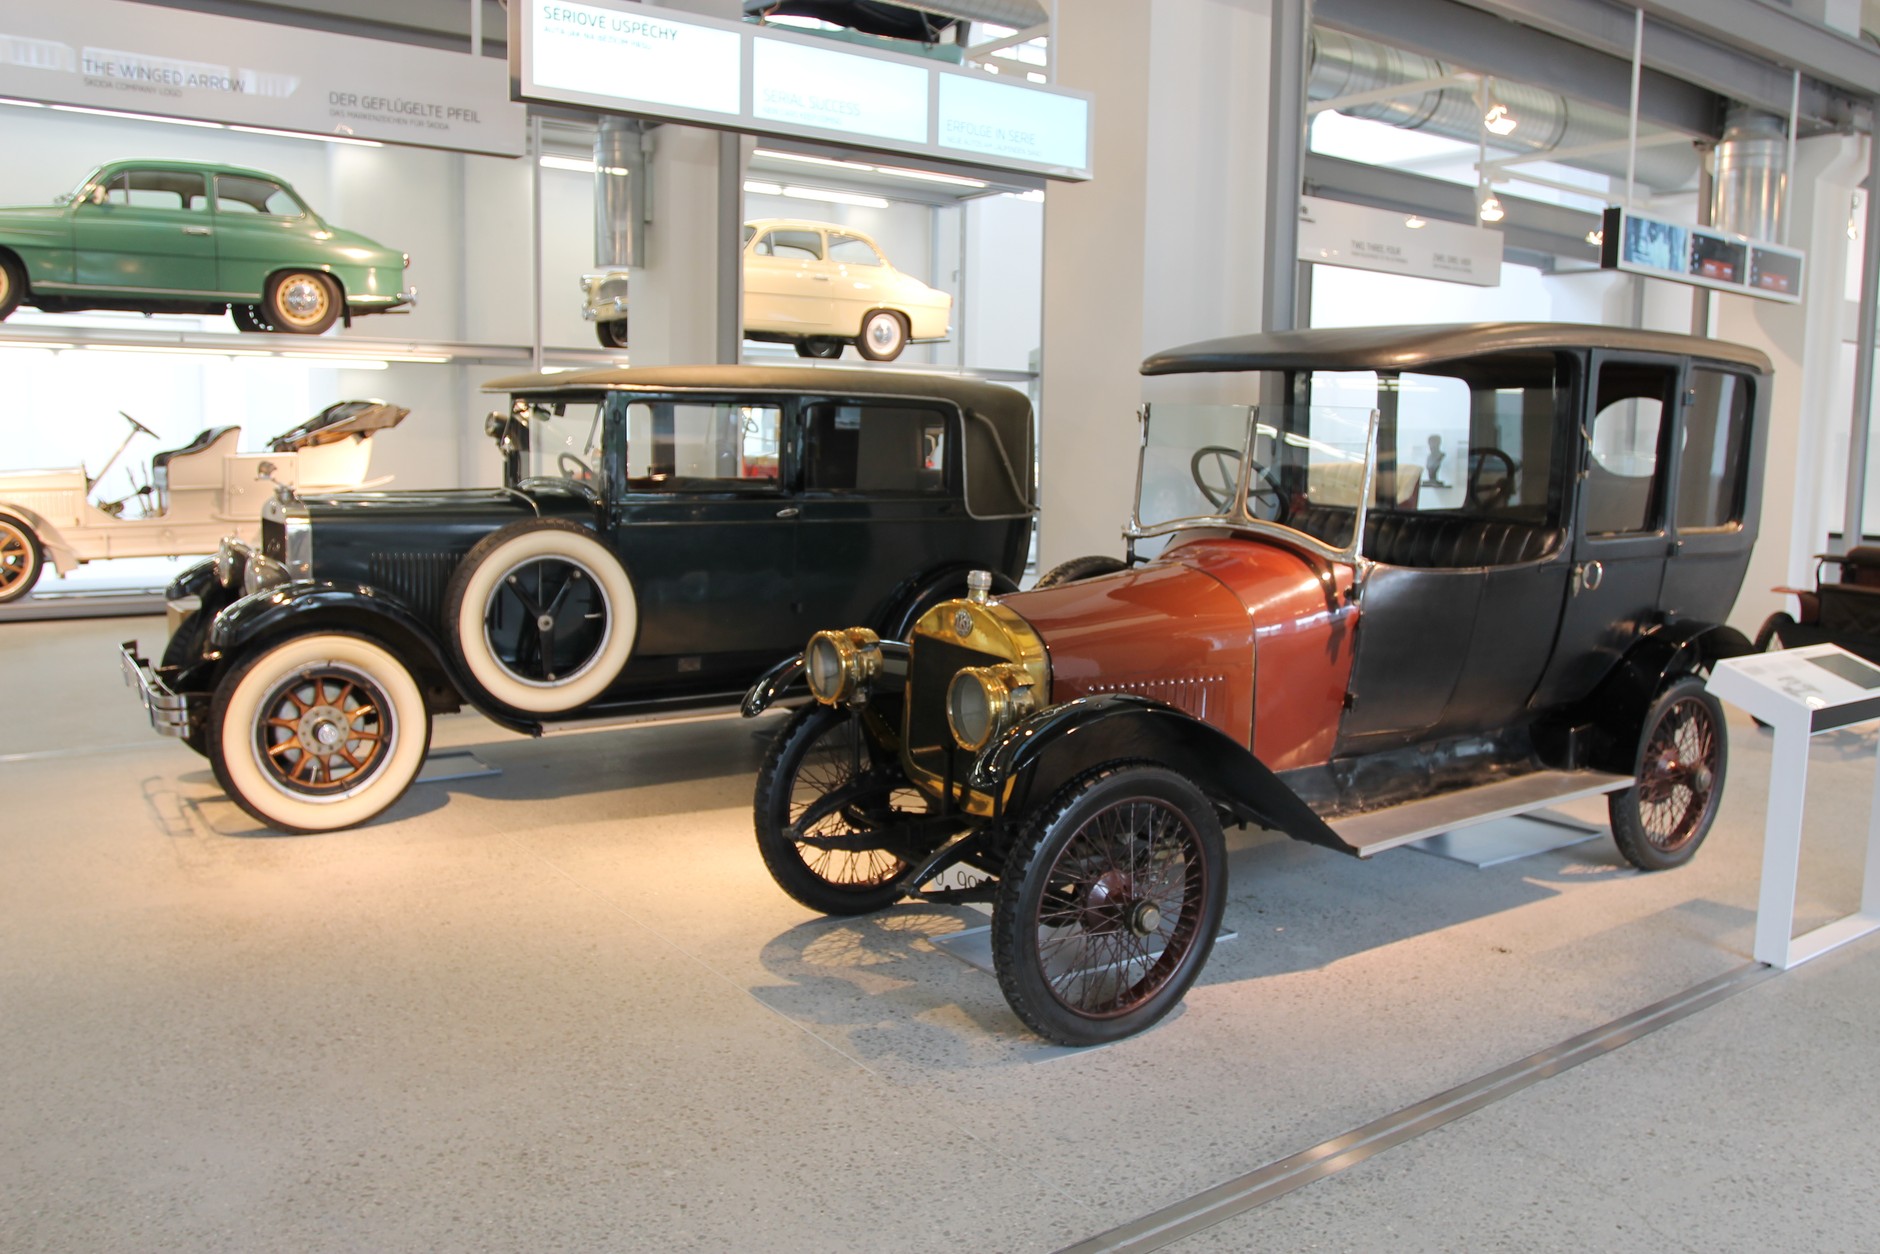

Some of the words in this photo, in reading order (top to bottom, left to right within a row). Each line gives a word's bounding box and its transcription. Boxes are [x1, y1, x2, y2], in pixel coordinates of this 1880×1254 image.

[83, 58, 116, 77] THE
[119, 64, 184, 86] WINGED
[187, 73, 246, 93] ARROW
[328, 91, 358, 107] DER
[361, 95, 443, 119] GEFLÜGELTE
[446, 106, 481, 123] PFEIL
